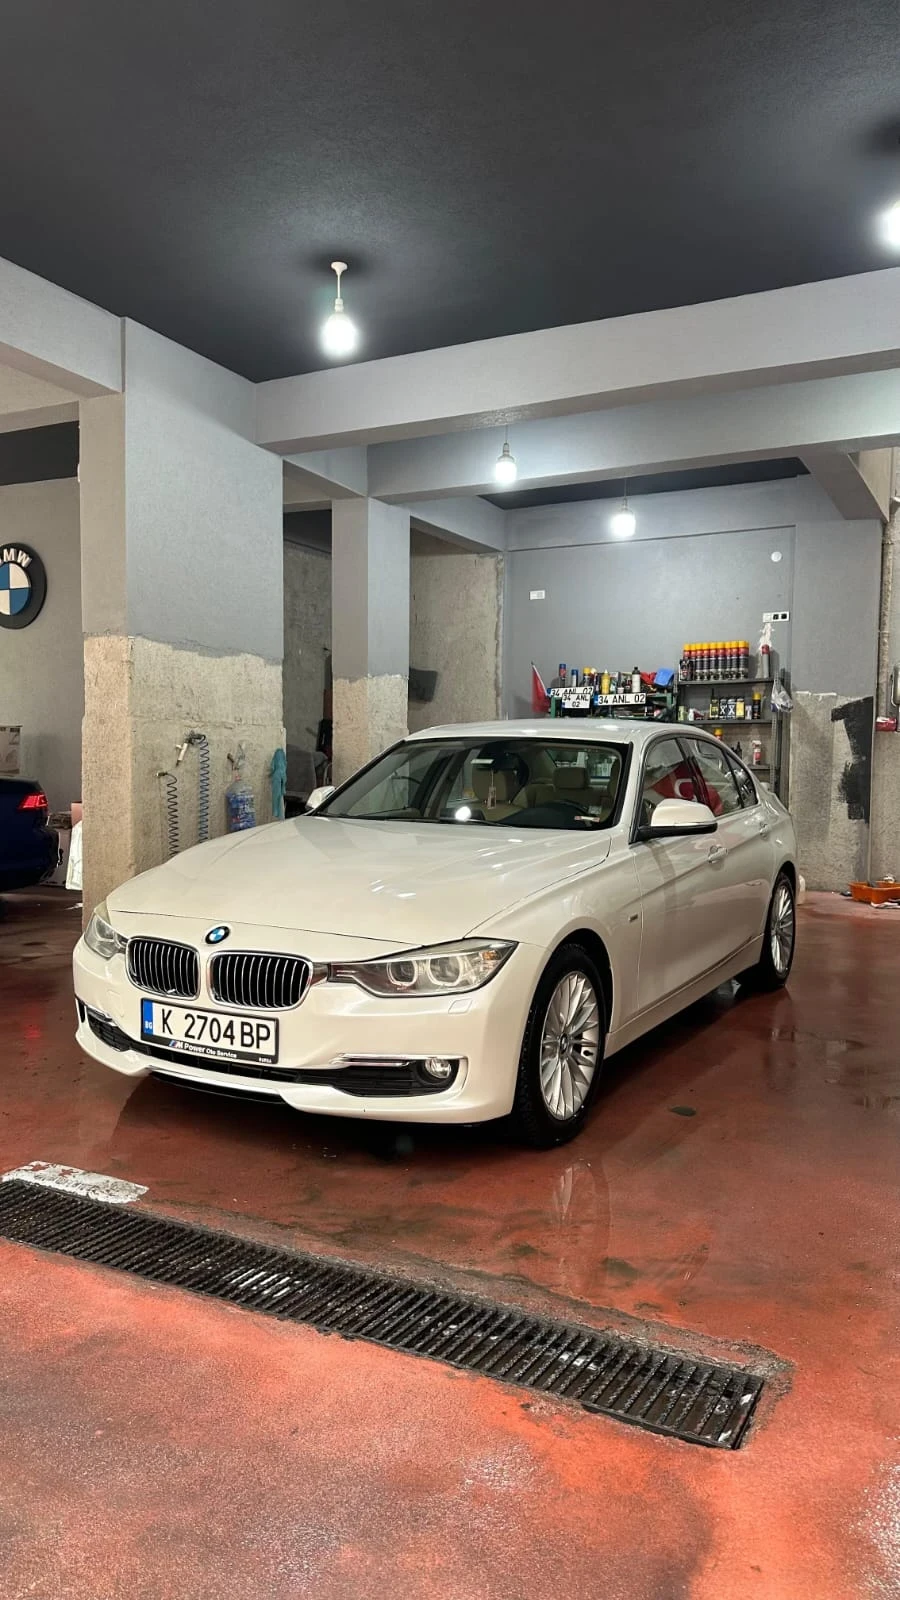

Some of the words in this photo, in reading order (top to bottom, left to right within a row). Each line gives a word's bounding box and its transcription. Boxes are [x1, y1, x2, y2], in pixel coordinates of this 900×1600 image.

[599, 695, 609, 704] 34
[612, 695, 630, 704] ANL
[634, 694, 645, 703] 02
[144, 1020, 152, 1030] BG
[162, 1008, 173, 1035] K
[184, 1043, 205, 1054] Power
